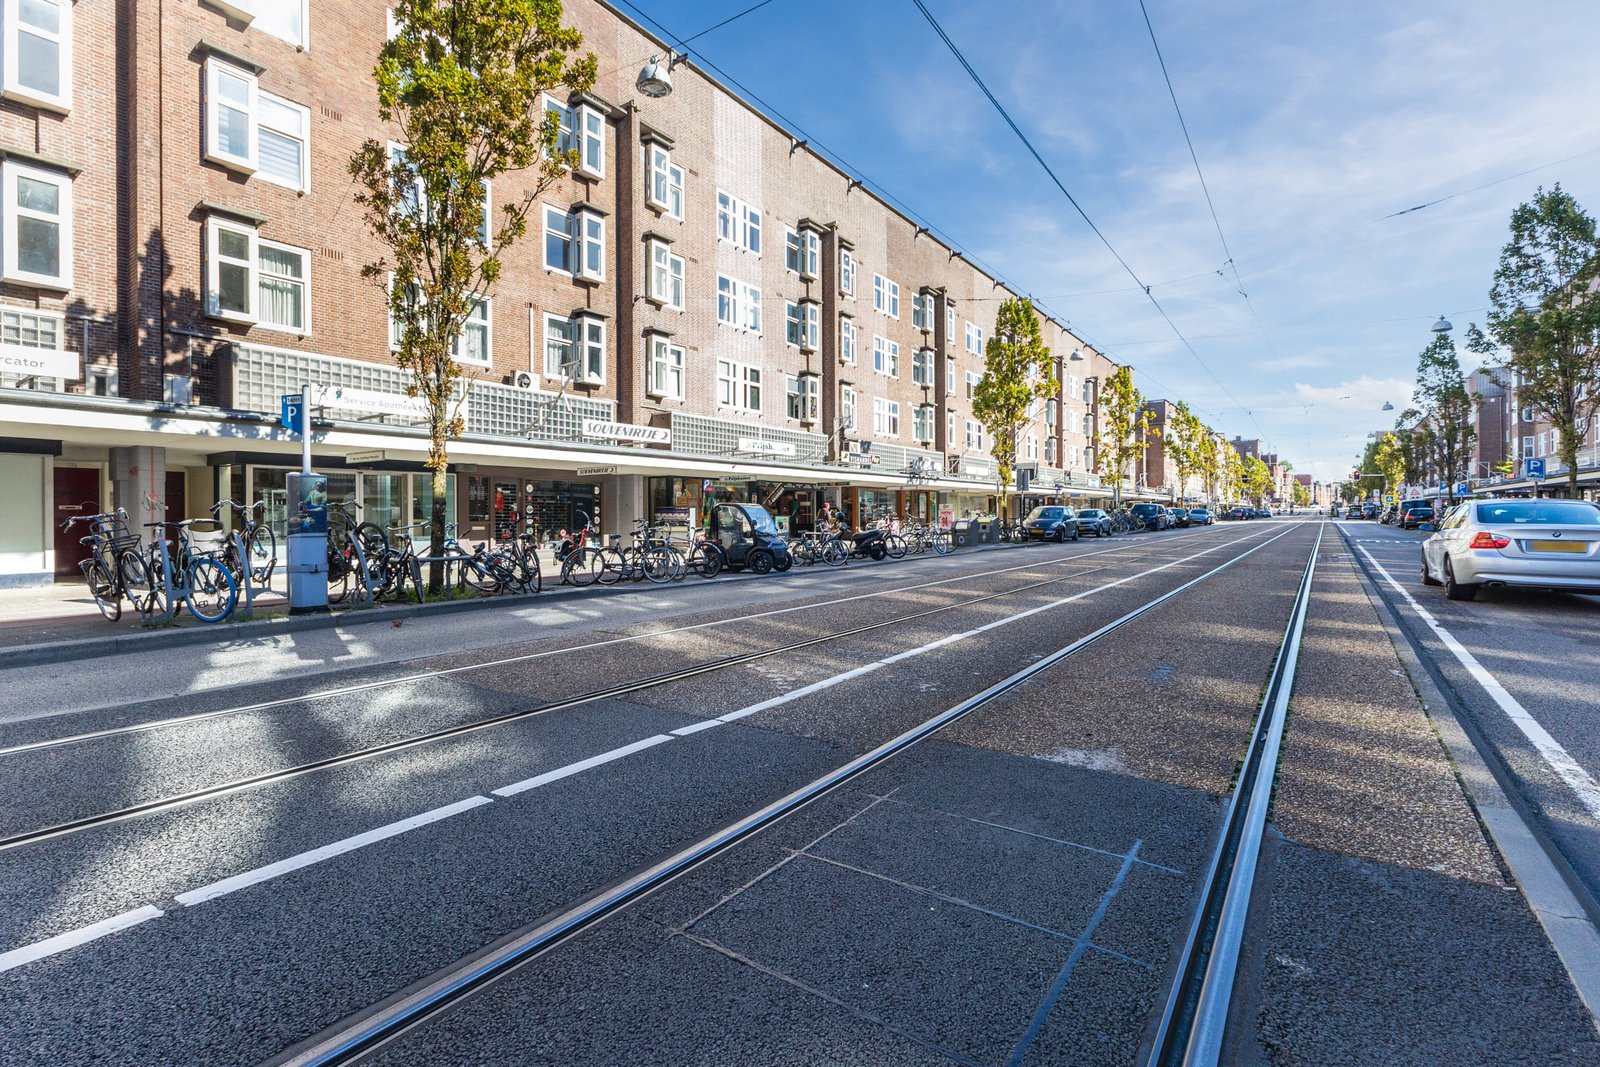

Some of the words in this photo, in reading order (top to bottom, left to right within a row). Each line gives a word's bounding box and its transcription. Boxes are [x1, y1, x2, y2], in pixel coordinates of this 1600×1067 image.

[343, 396, 376, 407] Service
[287, 406, 297, 422] P
[586, 422, 658, 439] SOUVENIRTJE
[661, 431, 668, 440] 2
[1530, 460, 1541, 471] P
